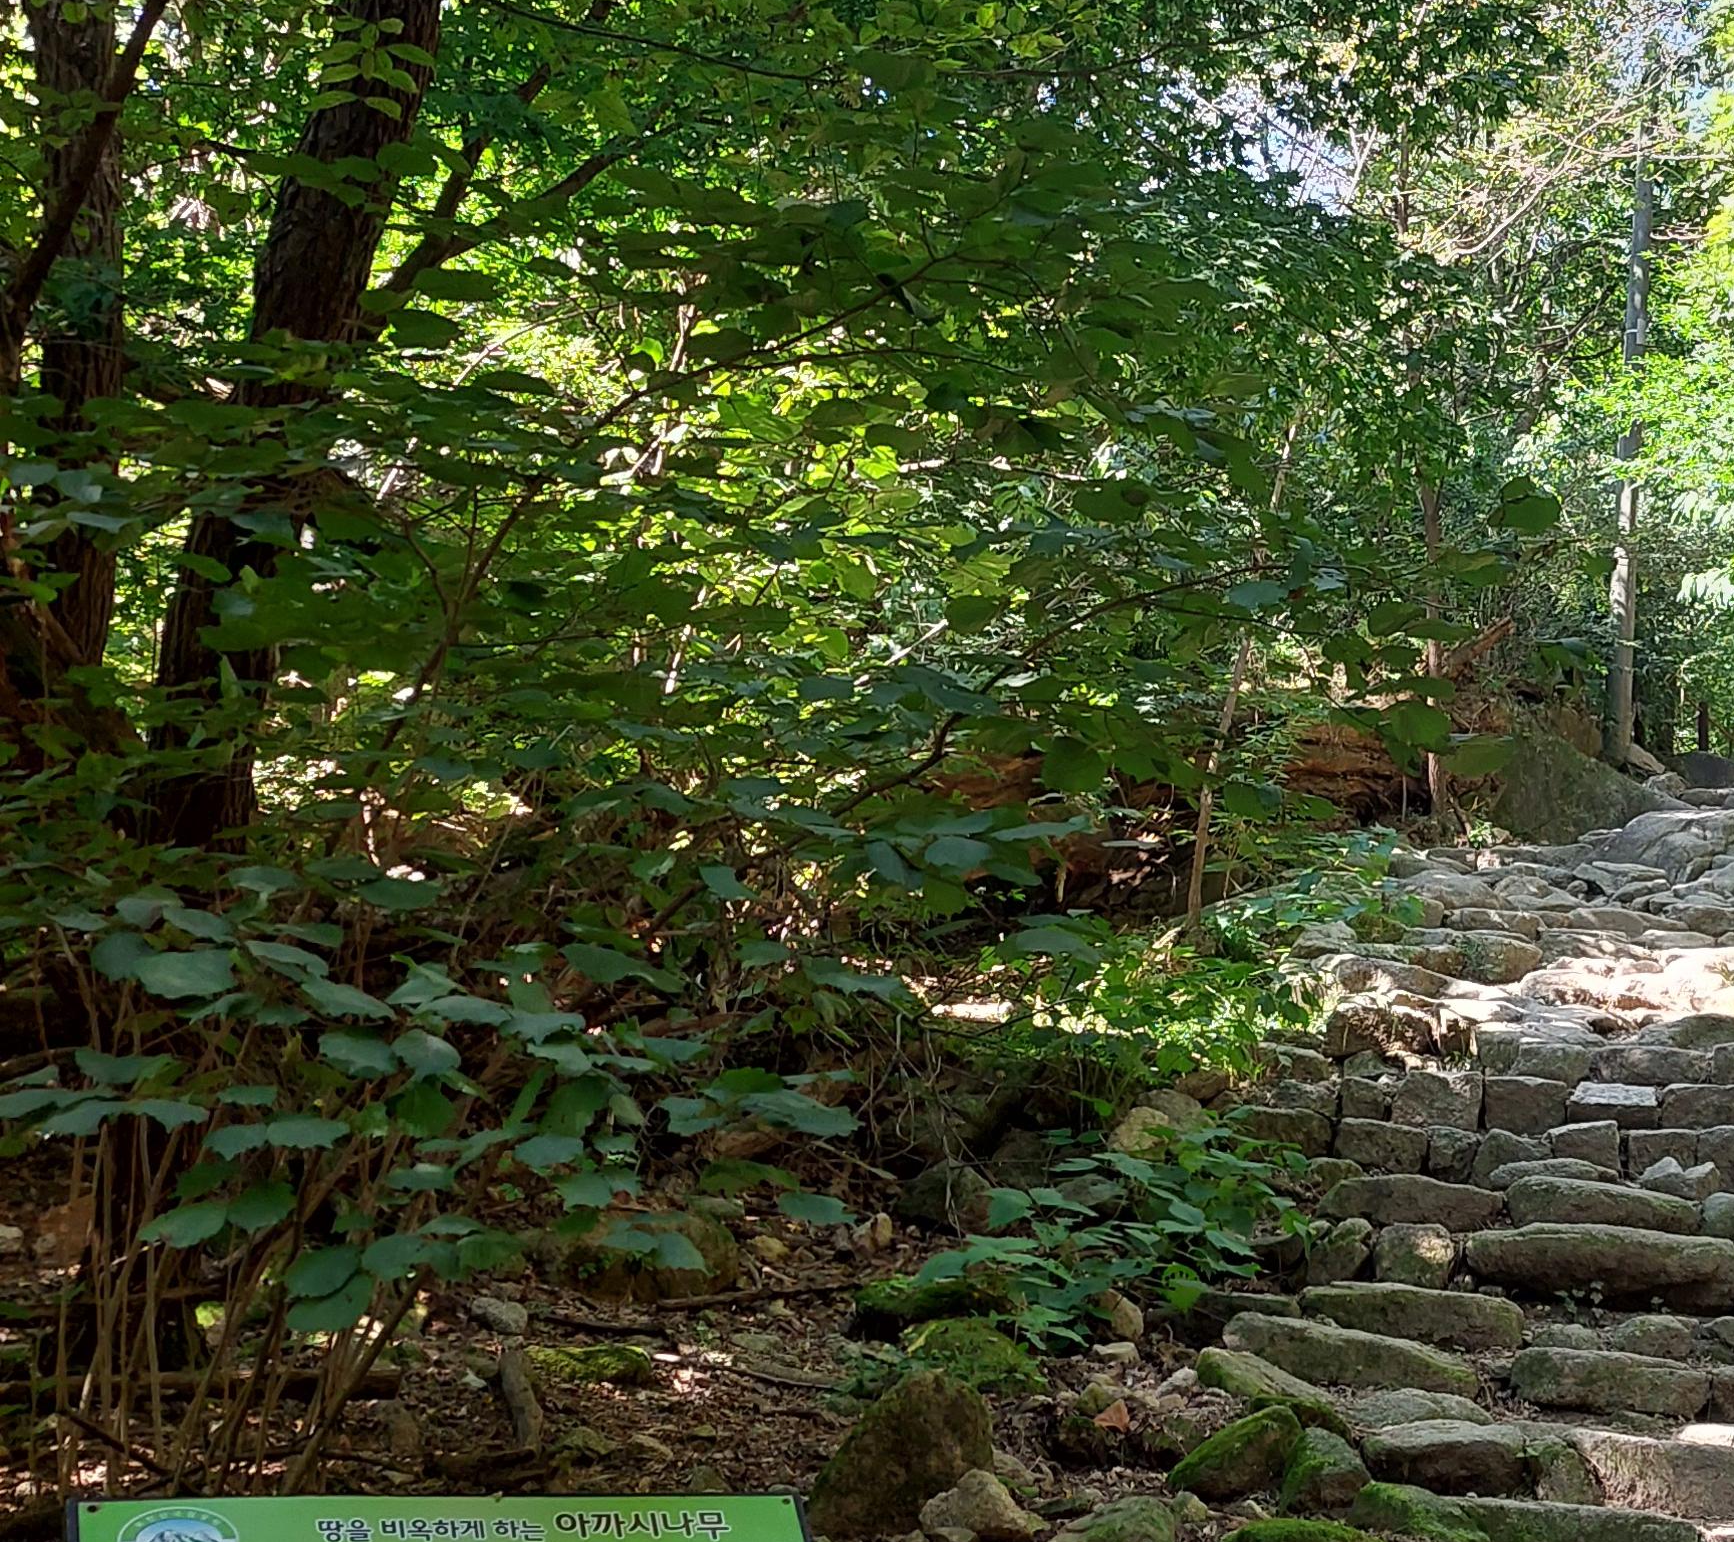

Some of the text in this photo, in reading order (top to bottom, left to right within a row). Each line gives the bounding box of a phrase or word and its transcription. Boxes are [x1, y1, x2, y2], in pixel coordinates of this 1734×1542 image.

[381, 1519, 486, 1542] 비옥하게
[494, 1518, 544, 1542] 하는
[555, 1510, 730, 1540] 아까시나무
